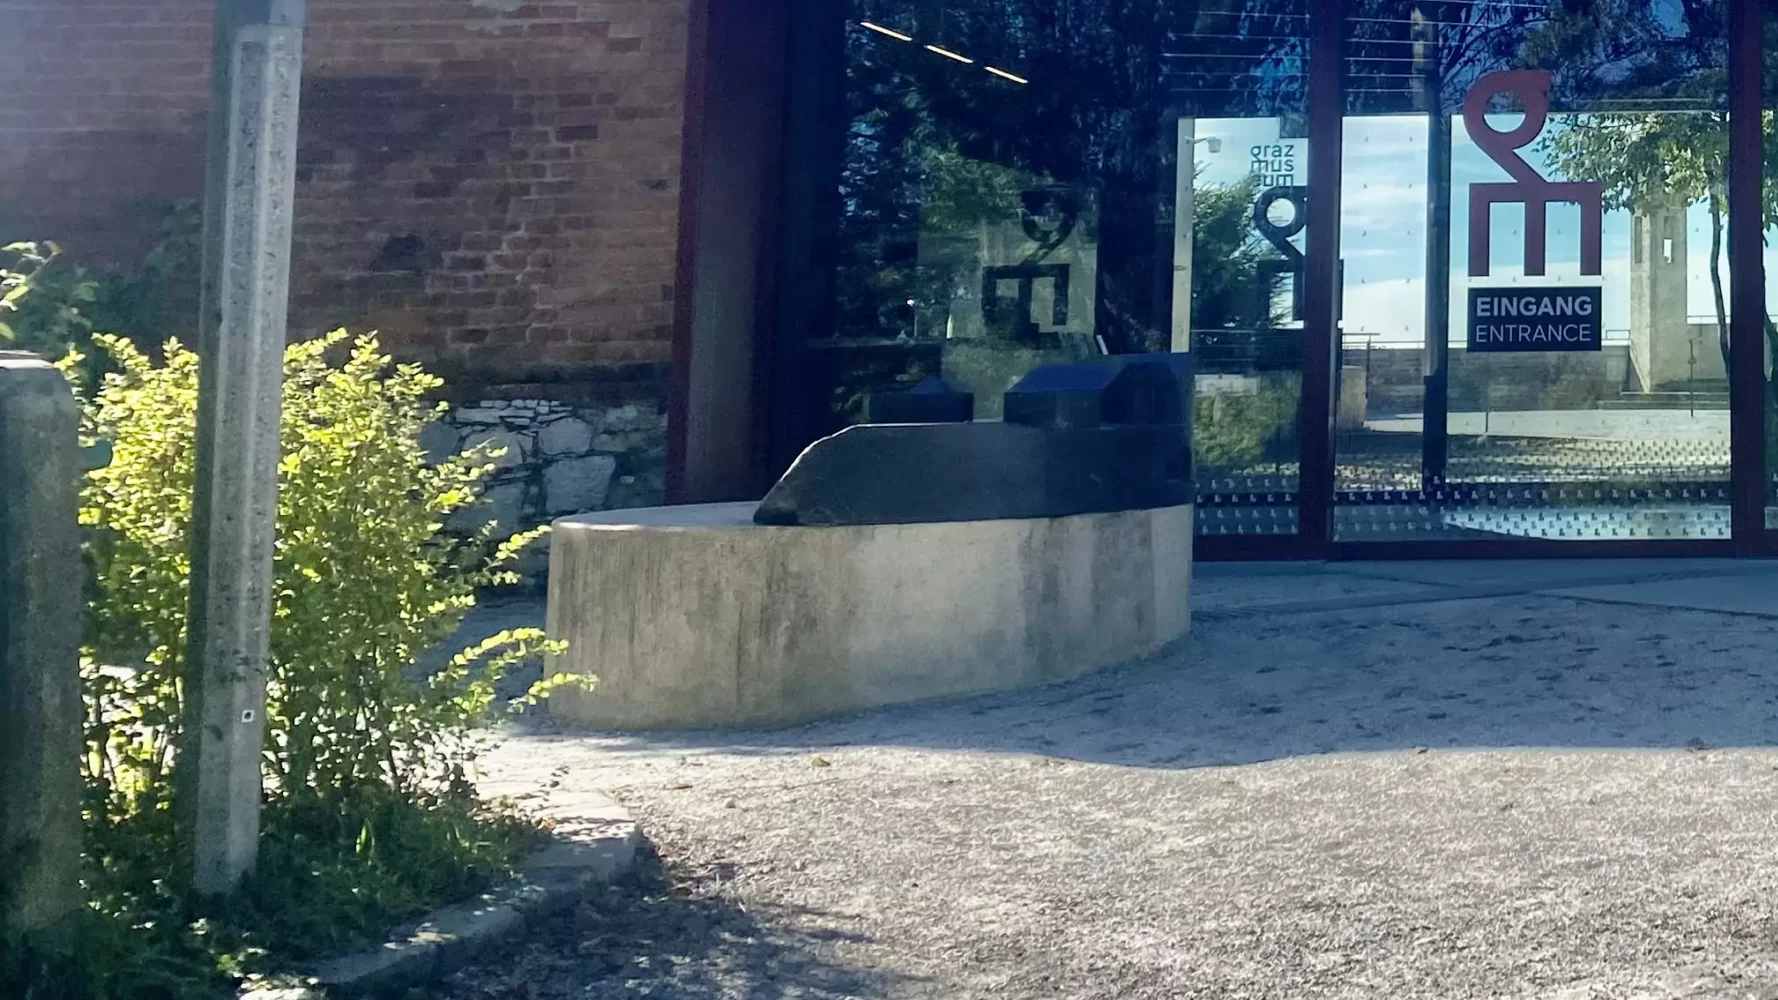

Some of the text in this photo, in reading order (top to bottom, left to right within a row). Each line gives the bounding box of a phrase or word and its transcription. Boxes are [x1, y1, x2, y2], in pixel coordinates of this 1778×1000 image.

[1250, 144, 1294, 161] graz
[1475, 296, 1593, 317] EINGANG
[1475, 324, 1592, 343] ENTRANCE
